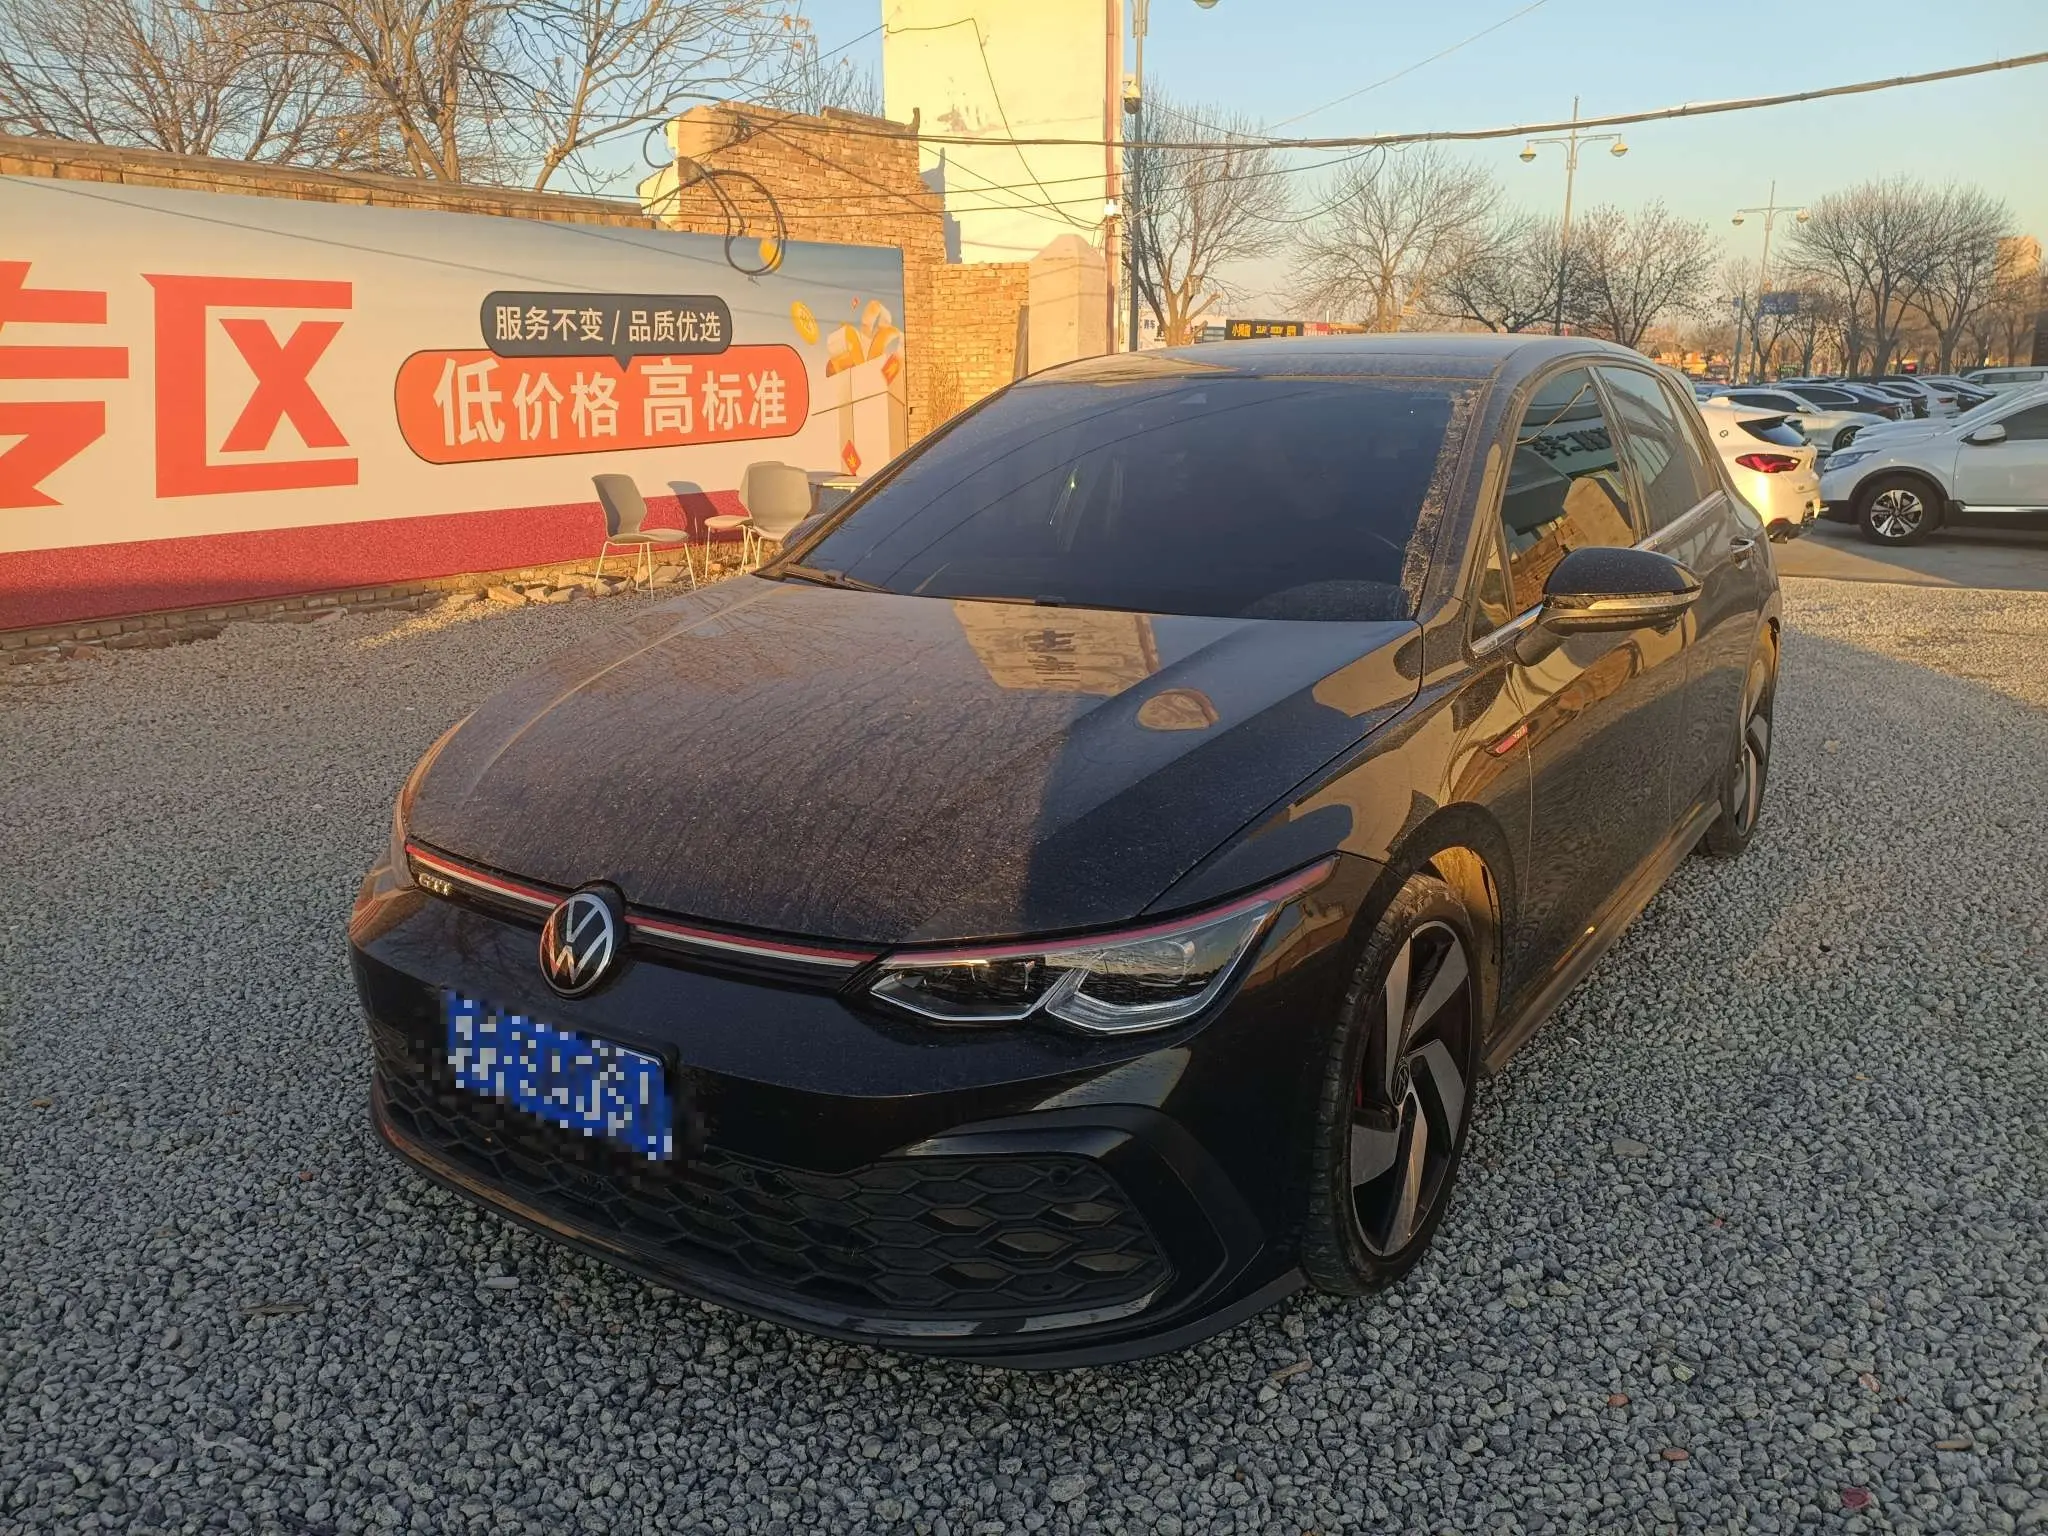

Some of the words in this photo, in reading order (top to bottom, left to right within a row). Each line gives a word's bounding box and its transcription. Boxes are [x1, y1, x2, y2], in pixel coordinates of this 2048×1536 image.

[495, 305, 604, 342] 服务不变
[628, 309, 722, 343] 品质优选
[433, 356, 620, 447] 低价格
[639, 356, 788, 437] 高标准
[418, 872, 454, 897] GTI
